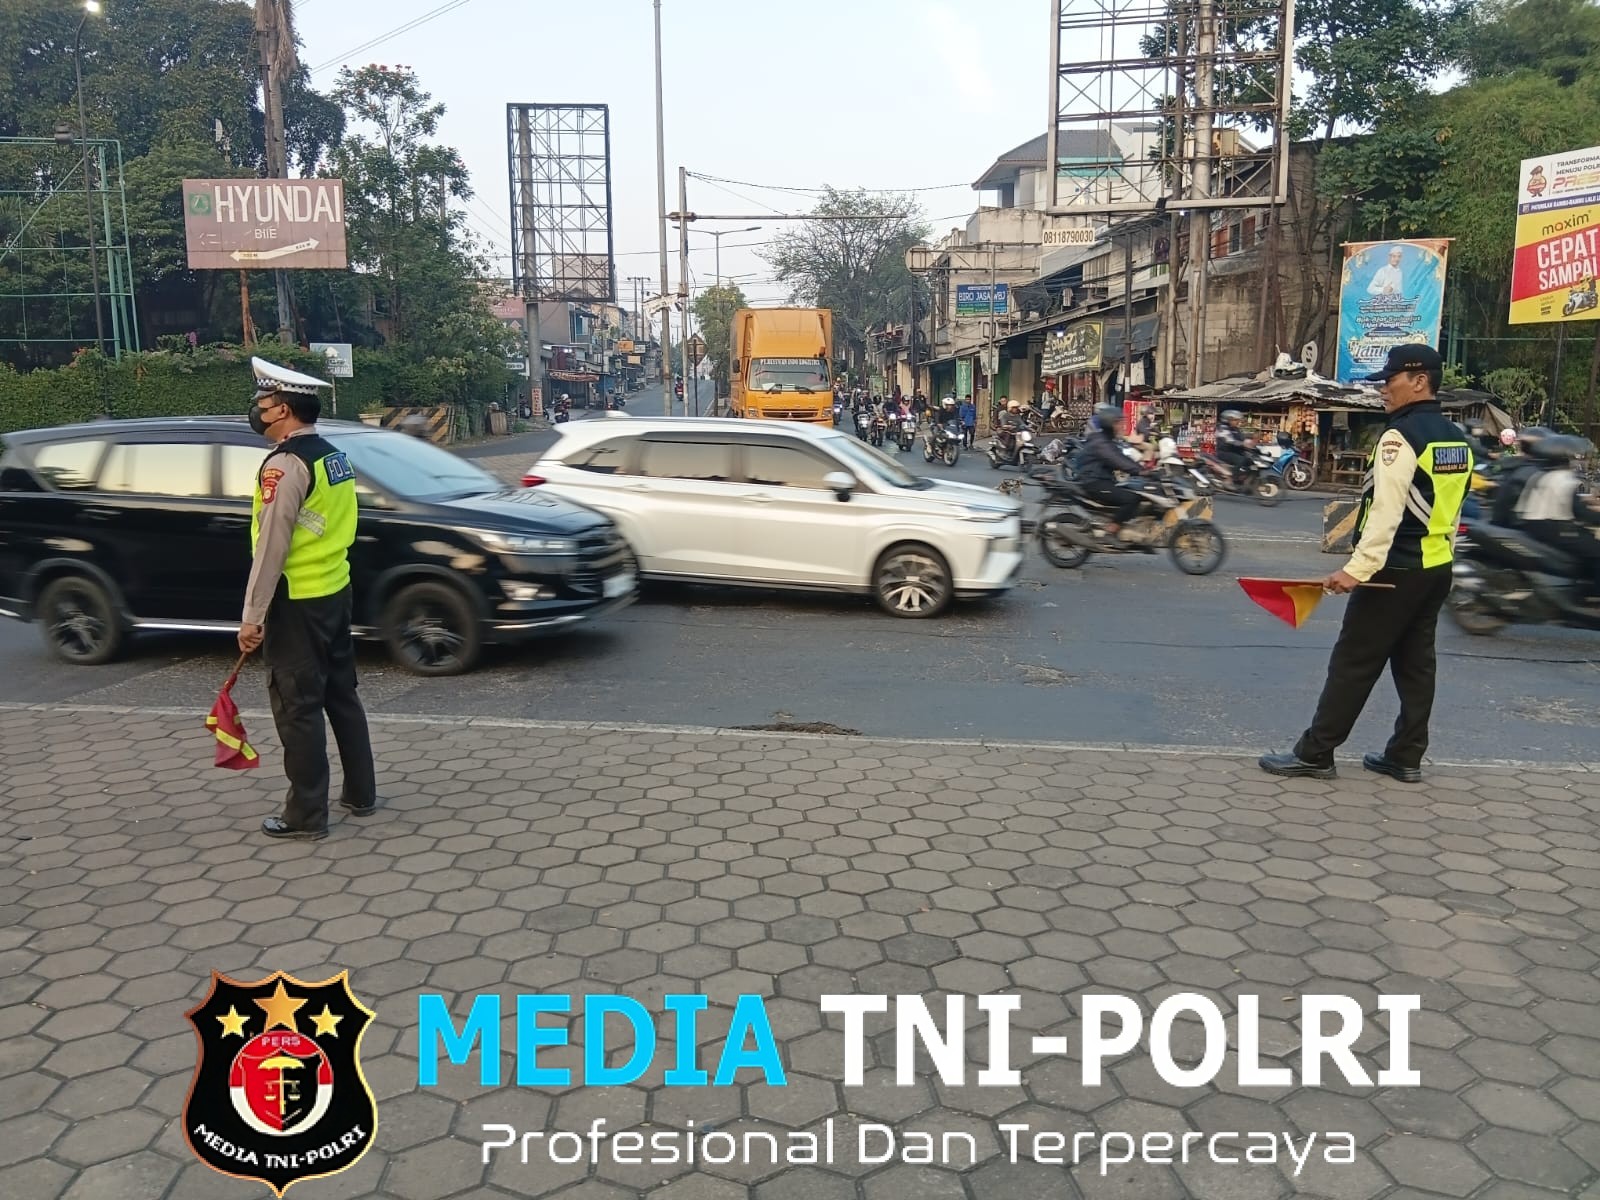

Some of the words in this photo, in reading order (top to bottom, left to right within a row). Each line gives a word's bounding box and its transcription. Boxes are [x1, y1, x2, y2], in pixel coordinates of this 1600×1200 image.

[214, 184, 341, 223] HYUNDAI
[1542, 213, 1589, 236] maxim
[1043, 229, 1094, 244] 08118790030
[1537, 228, 1599, 269] CEPAT
[1538, 256, 1598, 291] SAMPAI
[958, 292, 974, 301] BIRO
[1435, 447, 1467, 465] SECURITY
